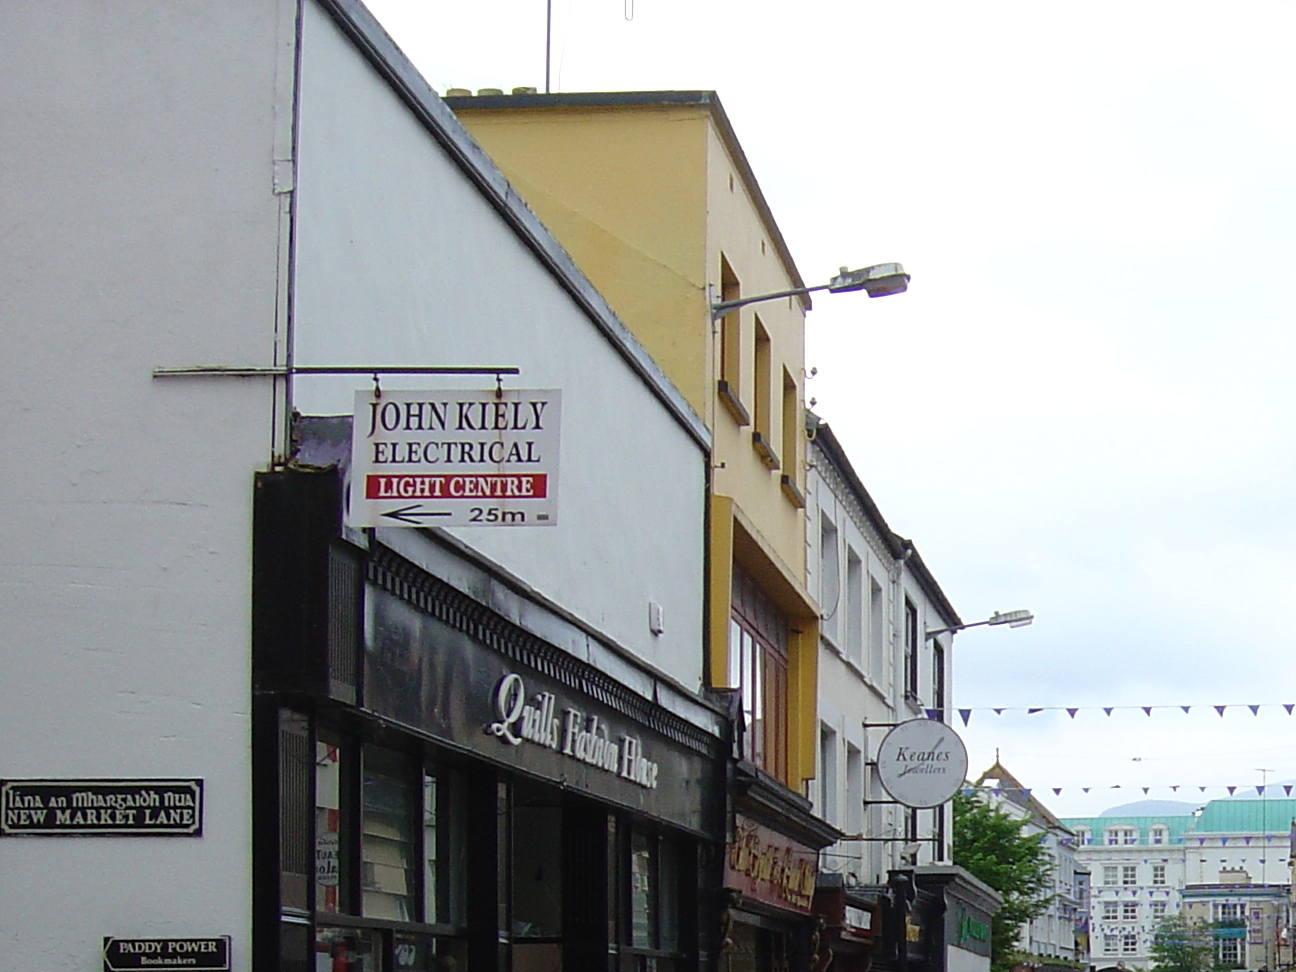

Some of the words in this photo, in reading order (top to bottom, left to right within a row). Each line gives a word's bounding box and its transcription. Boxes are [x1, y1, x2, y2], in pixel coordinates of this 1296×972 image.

[367, 401, 449, 438] JOHN
[455, 401, 548, 431] KIELY
[372, 441, 541, 464] ELECTRICAL
[378, 477, 445, 497] LIGHT
[450, 476, 534, 497] CENTRE
[469, 507, 526, 523] 25m
[491, 673, 560, 750] Quills
[563, 707, 619, 773] Fashion
[896, 746, 951, 762] Keanes
[50, 797, 67, 808] an
[7, 810, 48, 825] NEW
[55, 809, 137, 825] MARKET
[144, 809, 194, 825] LANE
[119, 941, 164, 954] PADDY
[168, 941, 218, 953] POWER
[140, 956, 197, 965] Bookmakers
